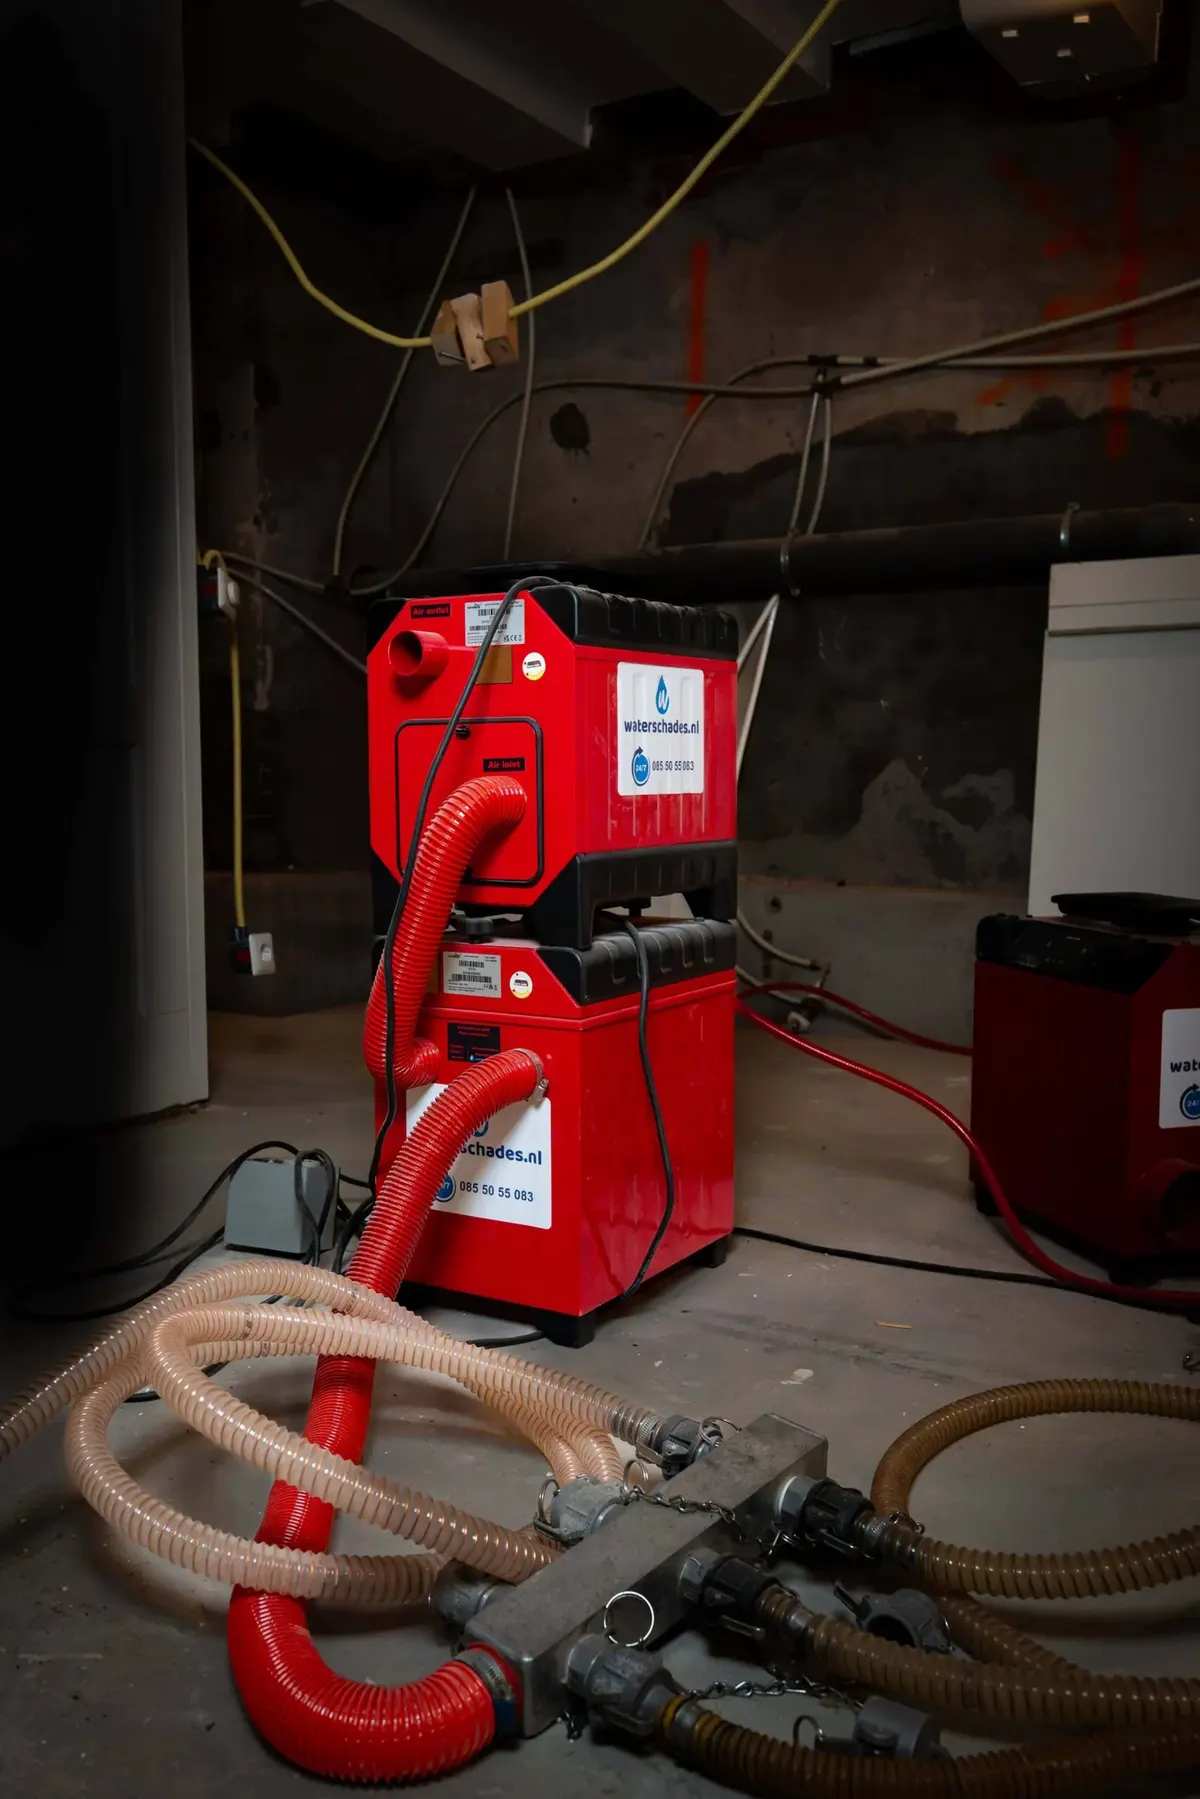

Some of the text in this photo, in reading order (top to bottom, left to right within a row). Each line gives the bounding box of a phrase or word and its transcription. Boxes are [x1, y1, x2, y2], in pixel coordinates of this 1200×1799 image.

[413, 606, 449, 615] Air outlet
[624, 718, 699, 734] waterschades.nl
[487, 760, 521, 769] Air inlet
[635, 763, 647, 772] 24/7
[652, 760, 695, 771] 085 50 55 083
[460, 1141, 542, 1165] schades.nl
[460, 1181, 534, 1202] 085 50 55 083
